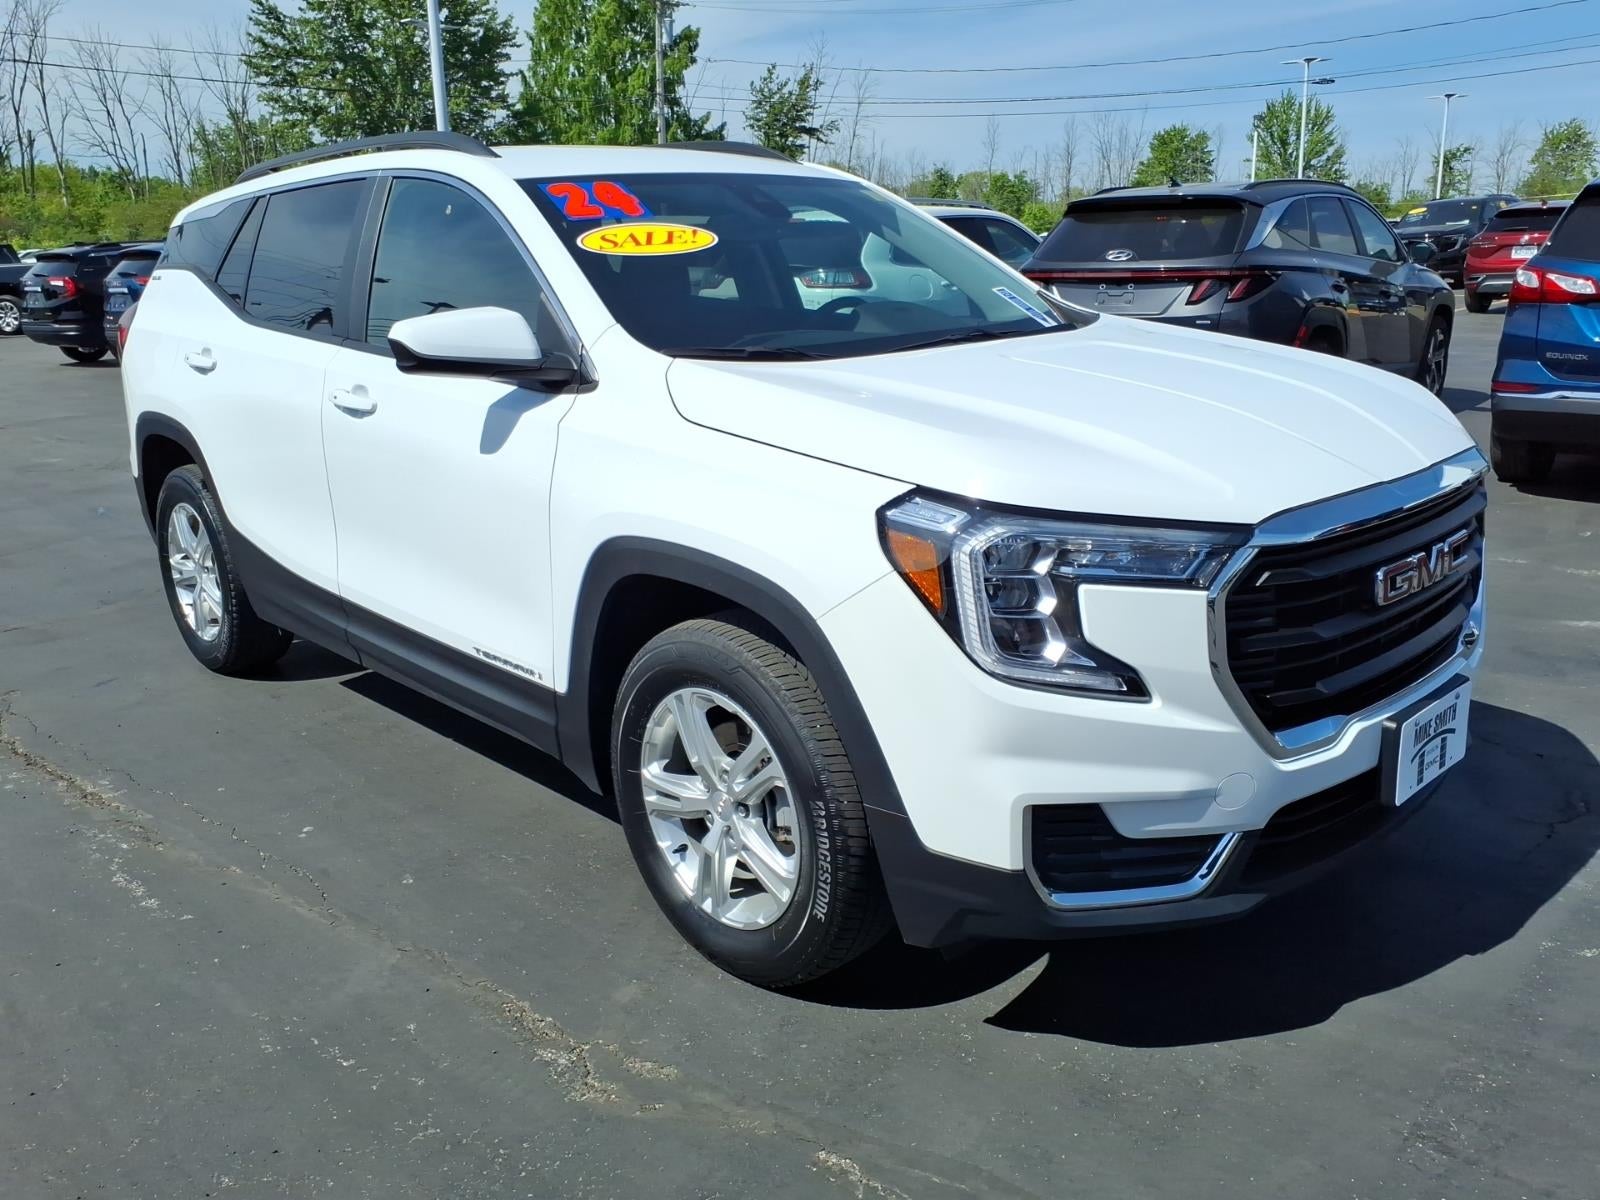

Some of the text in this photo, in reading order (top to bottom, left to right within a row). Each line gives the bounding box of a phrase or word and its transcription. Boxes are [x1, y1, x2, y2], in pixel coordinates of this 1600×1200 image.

[546, 181, 645, 217] 24
[599, 229, 699, 251] SALE!
[1546, 351, 1589, 361] EQUINOX
[1375, 529, 1468, 606] GMC
[1413, 702, 1458, 748] MIKE SMITH
[810, 800, 832, 923] BRIDGESTONE
